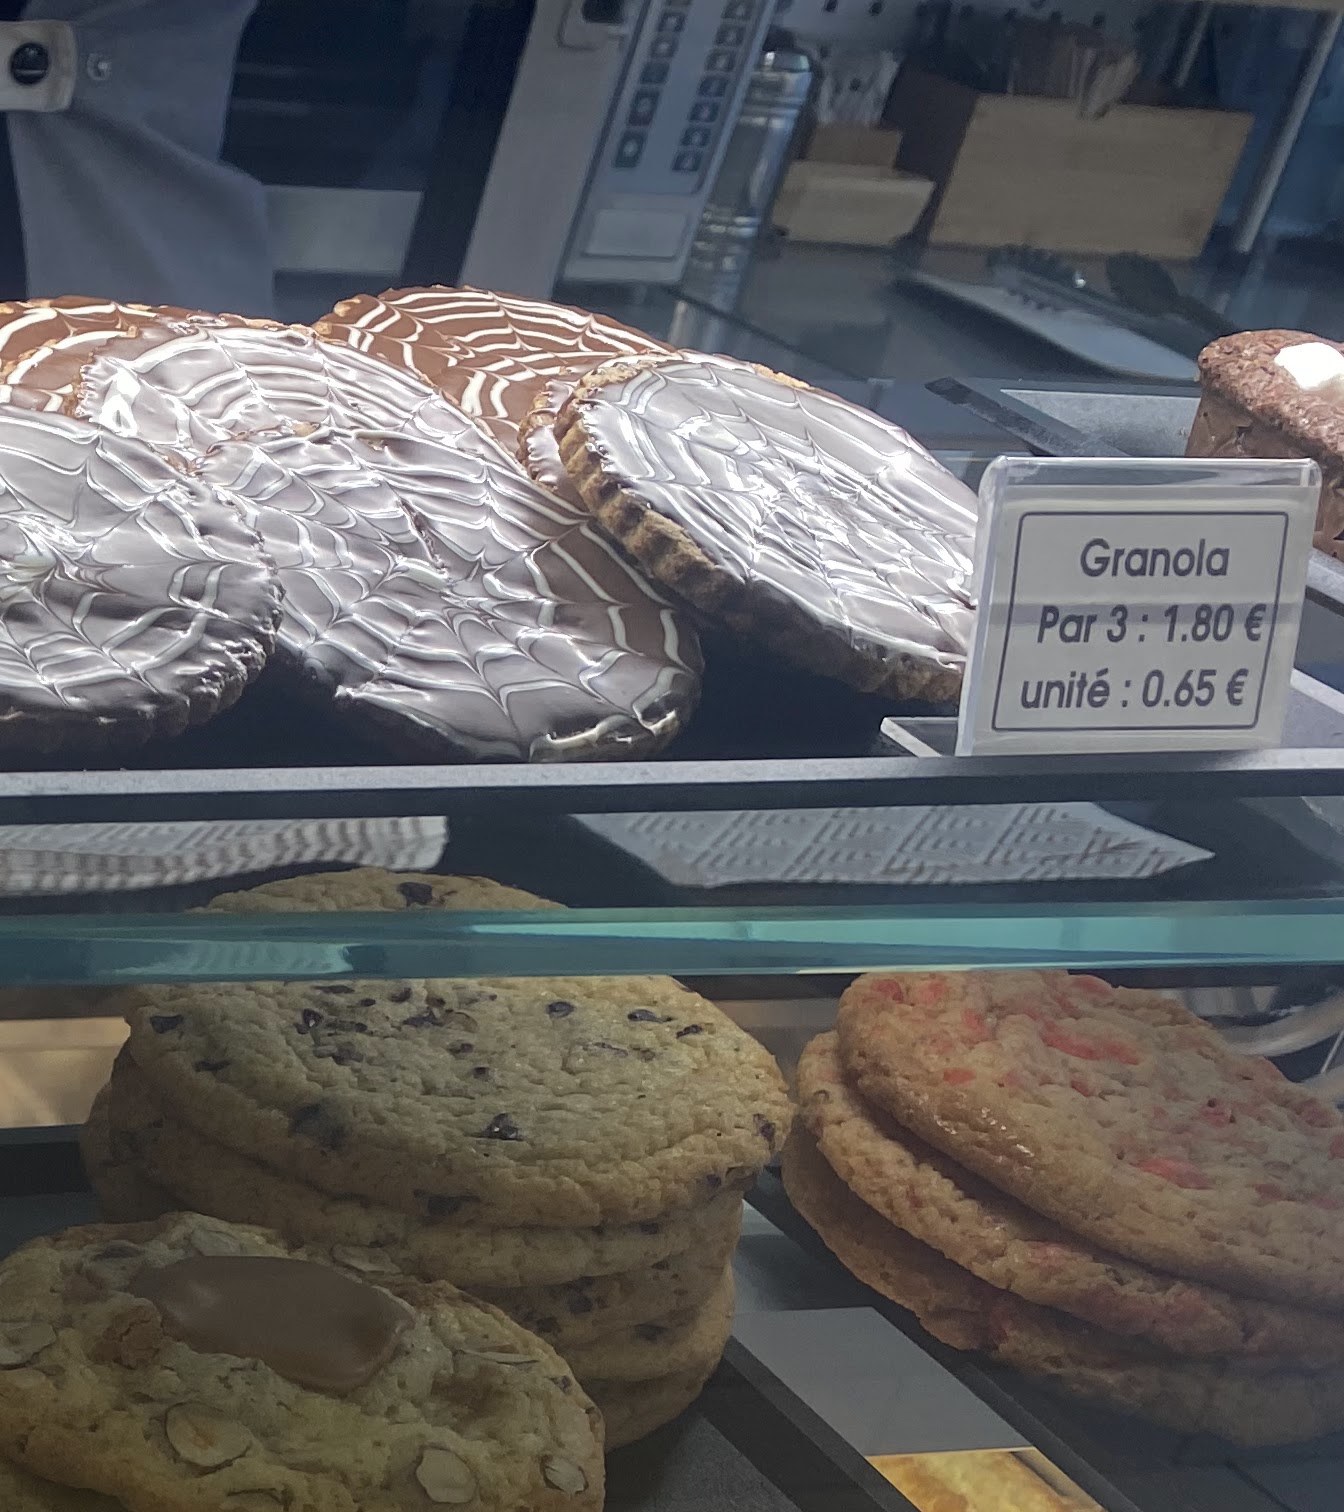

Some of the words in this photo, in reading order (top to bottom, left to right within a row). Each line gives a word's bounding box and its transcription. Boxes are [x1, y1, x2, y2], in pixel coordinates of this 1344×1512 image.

[1080, 538, 1230, 577] Granola
[1037, 605, 1097, 643] Par
[1106, 604, 1128, 643] 3
[1163, 603, 1234, 642] 1.80
[1244, 604, 1266, 642] €
[1021, 667, 1110, 709] unité
[1142, 669, 1217, 707] 0.65
[1226, 668, 1249, 706] €
